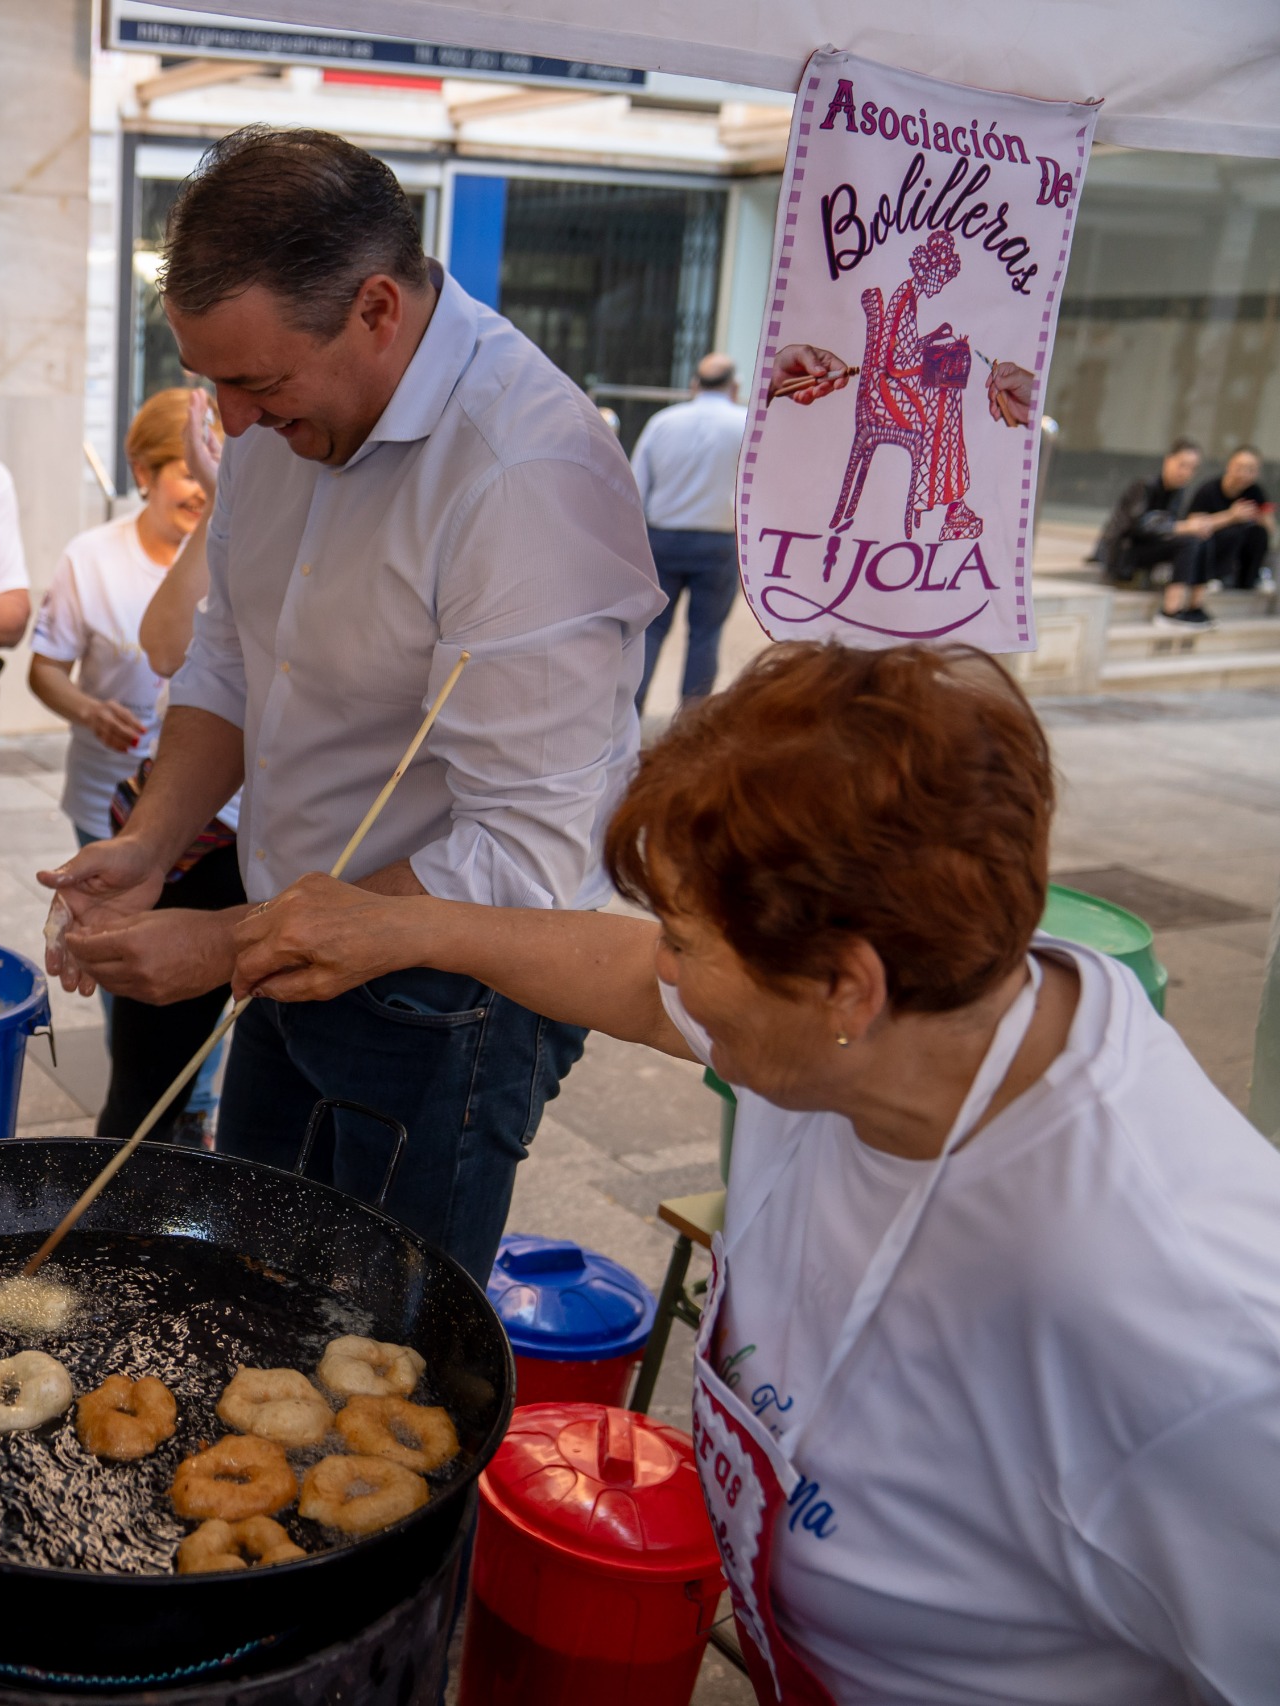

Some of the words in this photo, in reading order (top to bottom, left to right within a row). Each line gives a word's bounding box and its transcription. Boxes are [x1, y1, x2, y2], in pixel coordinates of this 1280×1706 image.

[819, 78, 1031, 165] Asociación
[1035, 155, 1074, 209] De
[820, 152, 1039, 296] Bolilleras
